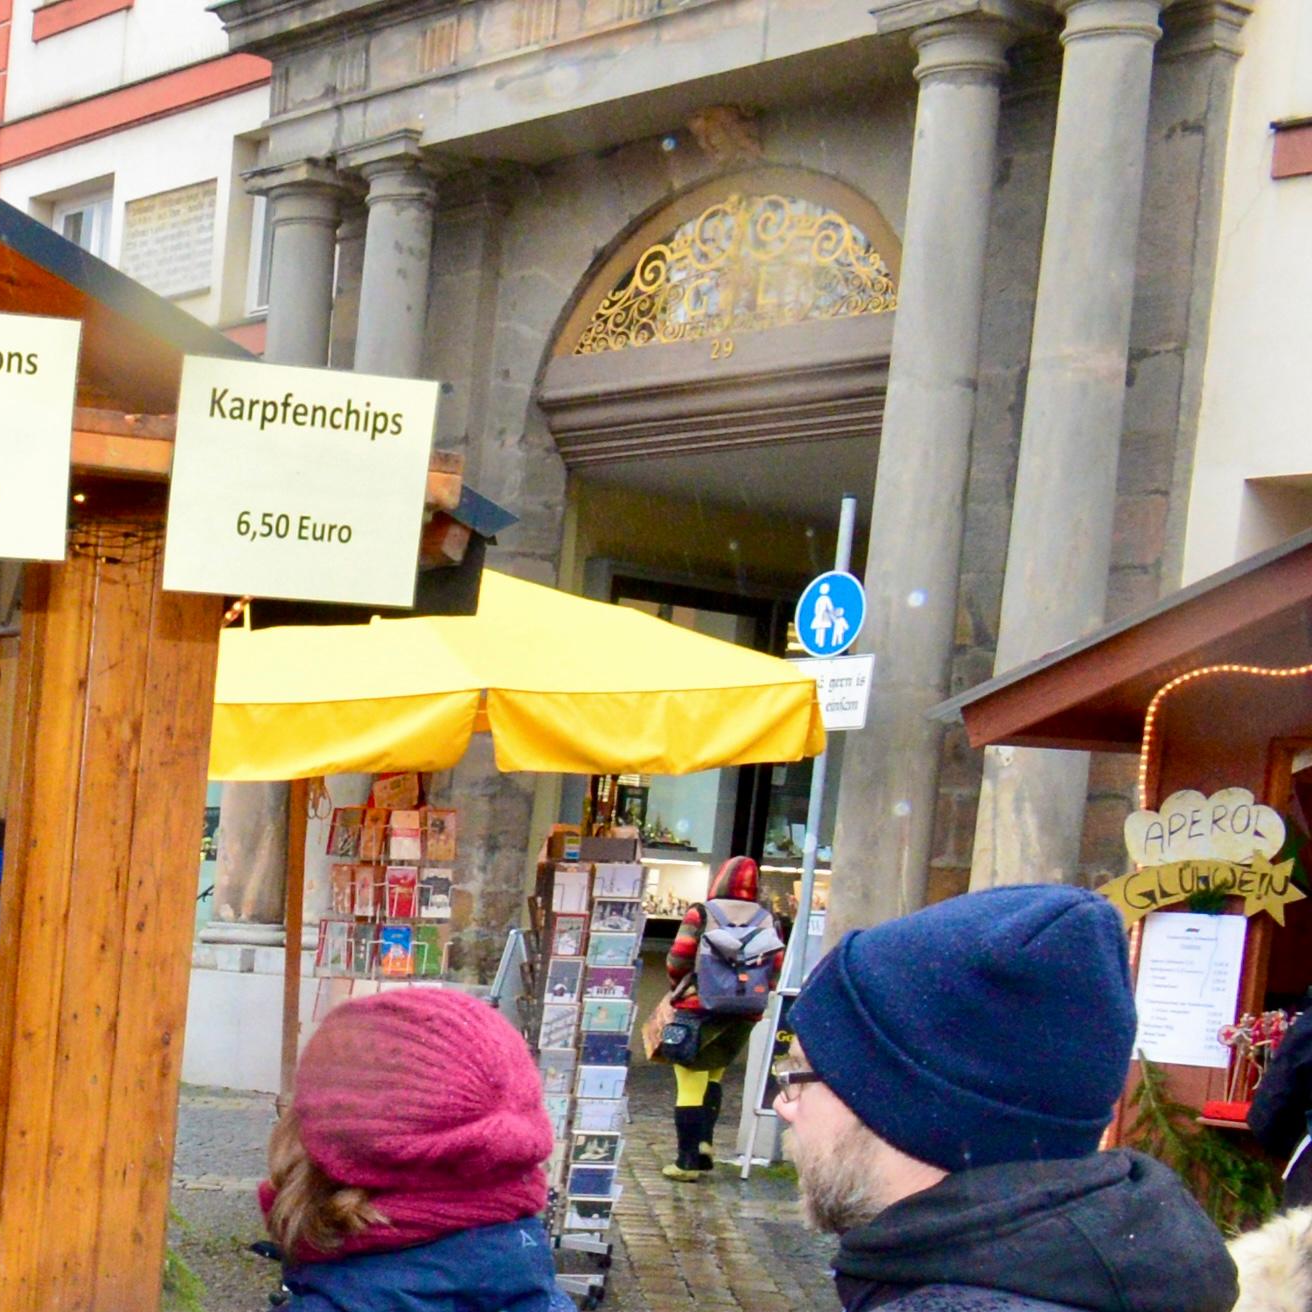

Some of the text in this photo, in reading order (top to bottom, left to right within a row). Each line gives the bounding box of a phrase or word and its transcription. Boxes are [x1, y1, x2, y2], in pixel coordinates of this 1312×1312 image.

[709, 338, 735, 360] 29
[208, 388, 403, 442] Karpfenchips
[236, 511, 353, 545] 6,50 Euro
[1143, 804, 1267, 854] APEROL
